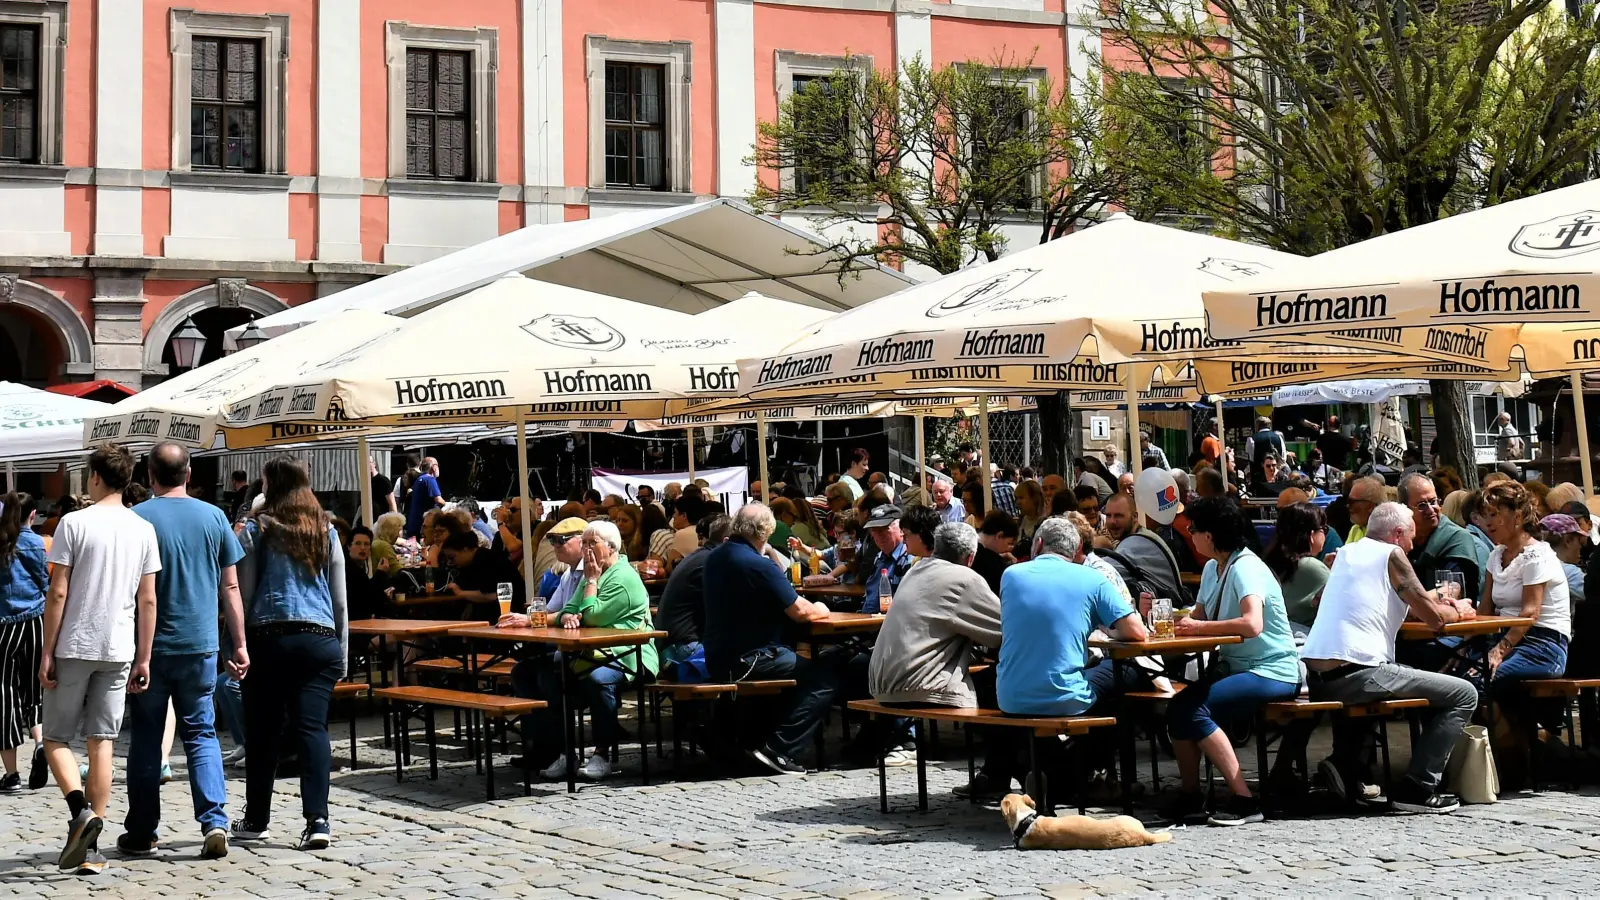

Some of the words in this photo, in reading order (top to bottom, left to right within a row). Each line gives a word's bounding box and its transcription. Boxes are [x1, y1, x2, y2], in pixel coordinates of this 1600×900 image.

[1256, 292, 1388, 327] Hofmann
[1440, 280, 1580, 313] Hofmann
[1141, 322, 1241, 351] Hofm
[758, 354, 832, 383] Hofmann
[857, 338, 934, 366] Hofmann
[959, 330, 1045, 356] Hofmann
[395, 378, 506, 405] Hofmann
[544, 370, 652, 394] Hofmann
[256, 394, 284, 418] Hofmann
[288, 388, 317, 411] Hofmann
[815, 403, 869, 415] Hofmann
[91, 419, 121, 439] Hofmann
[128, 414, 160, 434] Hofmann
[167, 416, 200, 440] Hofmann
